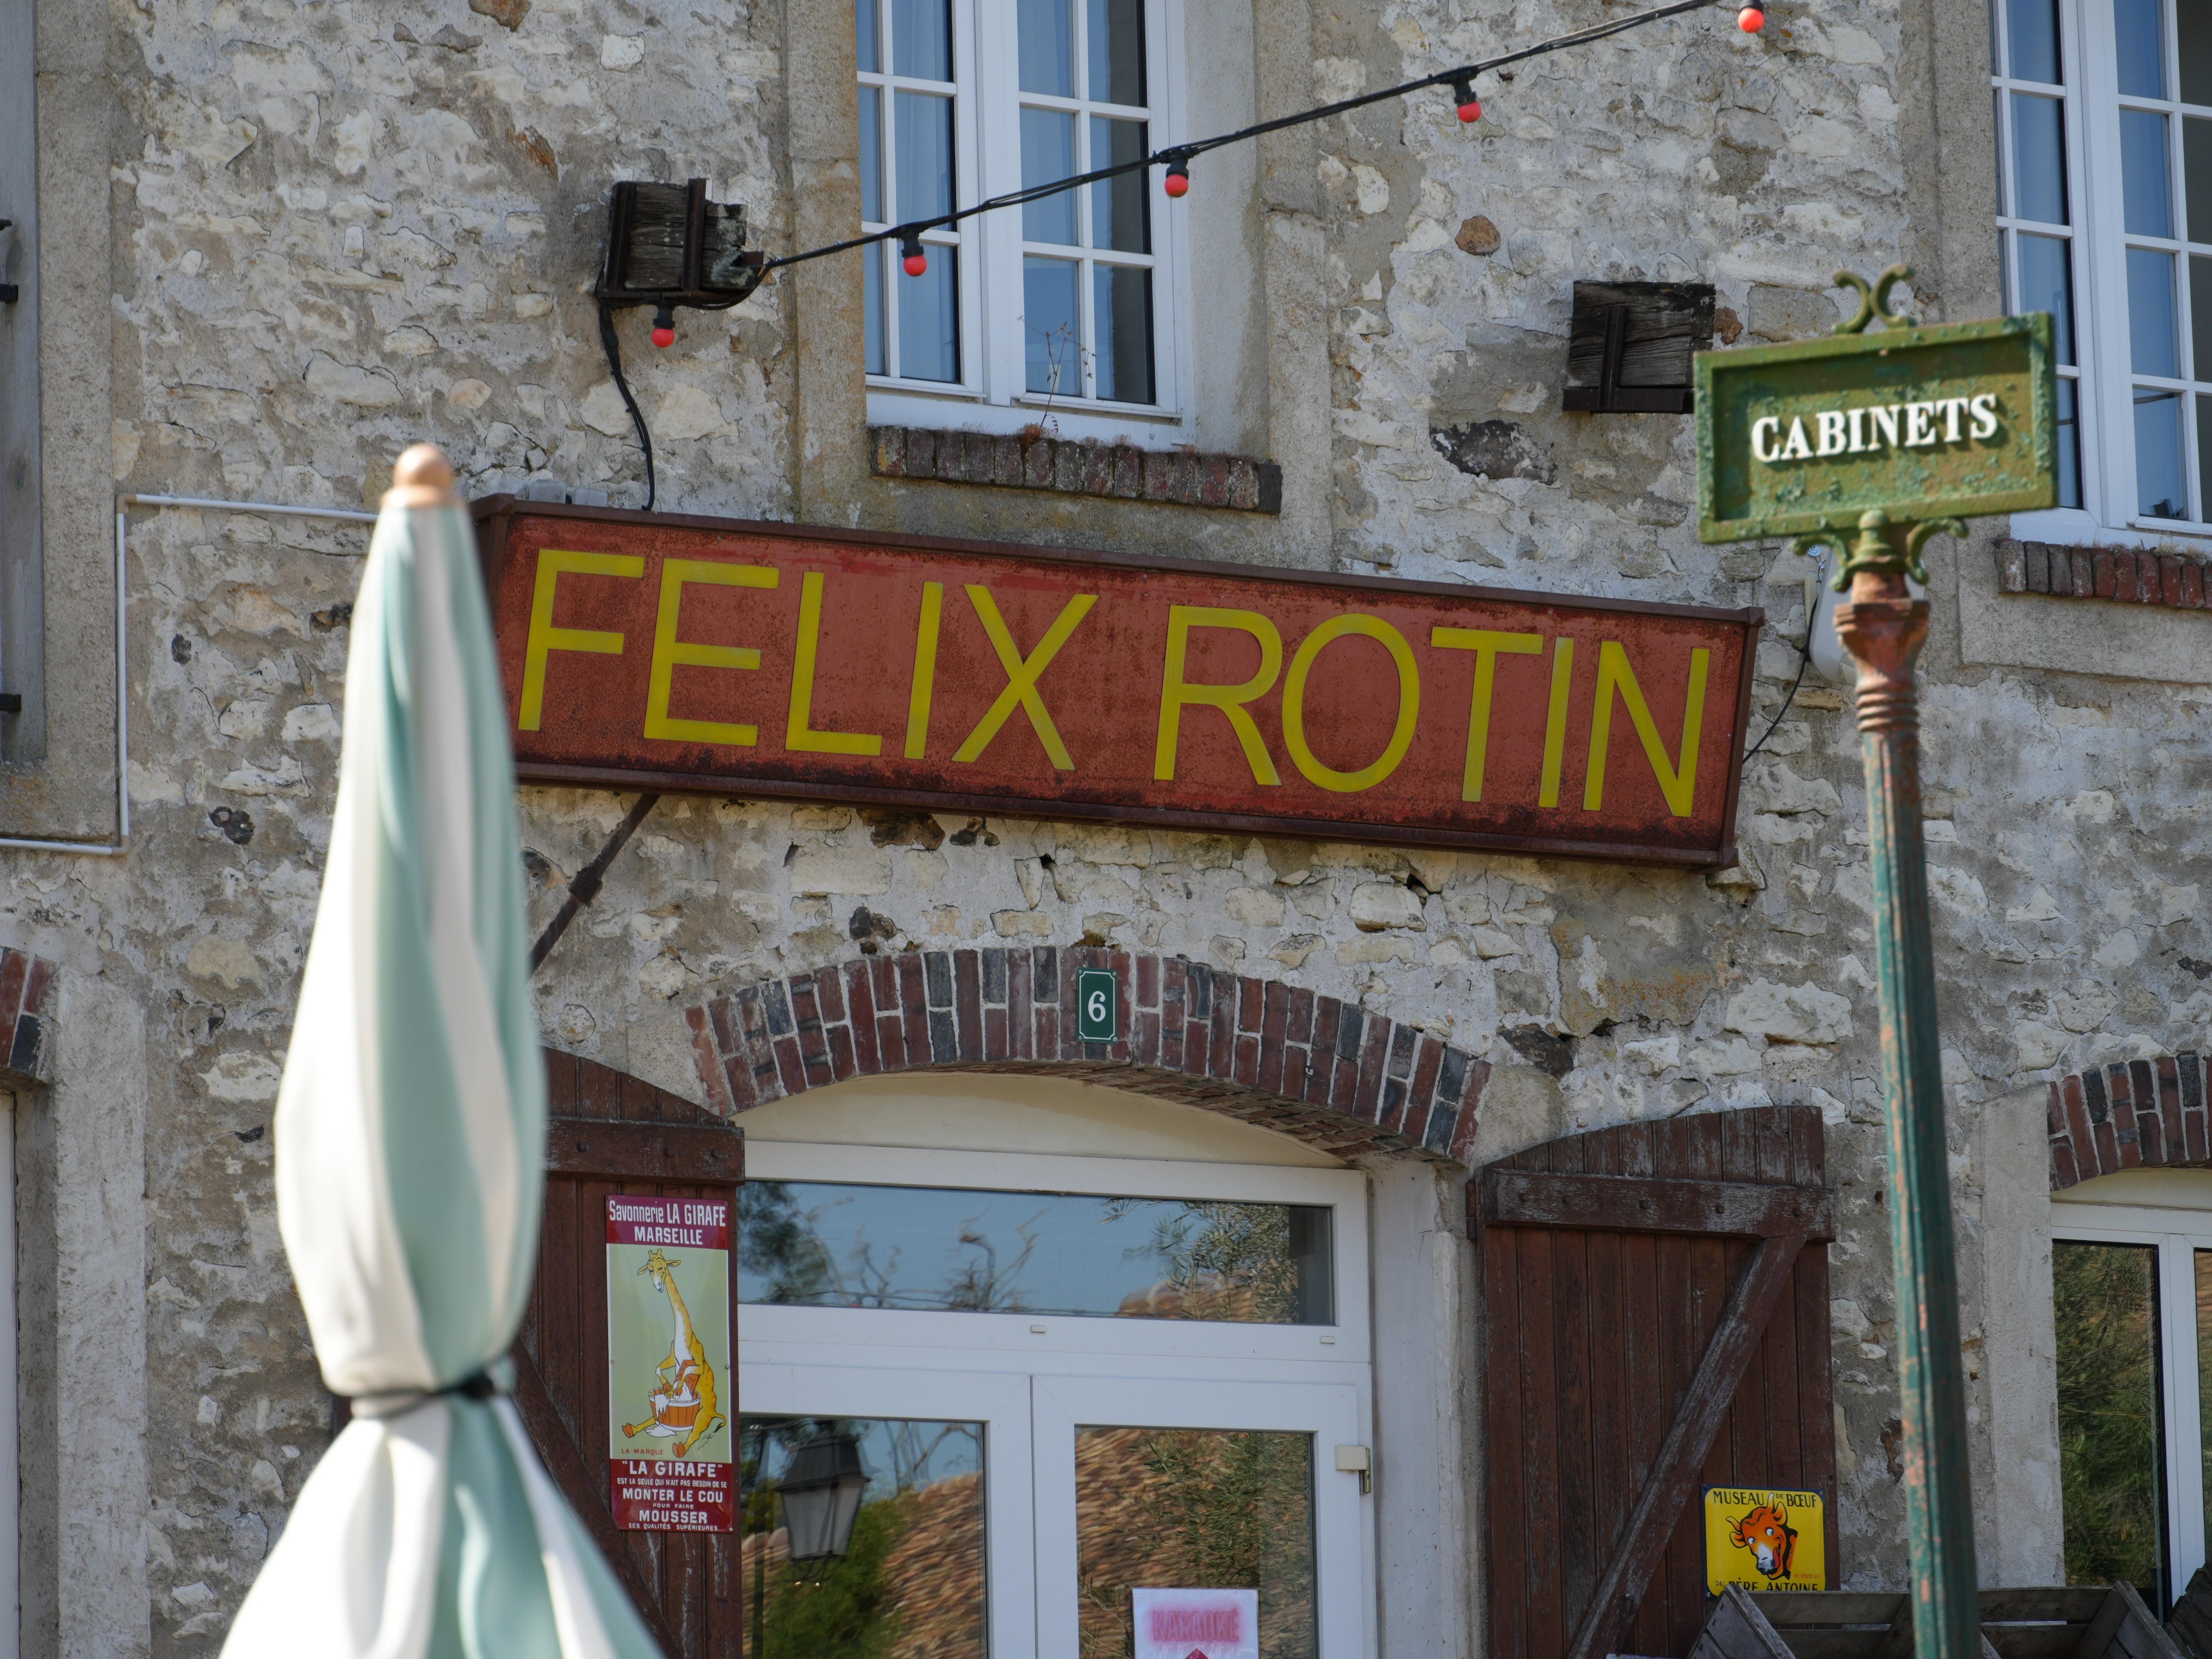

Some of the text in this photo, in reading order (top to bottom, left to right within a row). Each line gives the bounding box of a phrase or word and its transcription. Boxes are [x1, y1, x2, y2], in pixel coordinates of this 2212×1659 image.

[1751, 394, 1997, 463] CABINETS
[518, 549, 1710, 817] FELIX ROTIN
[1088, 991, 1106, 1022] 6
[609, 1200, 726, 1227] Savonnerie LA GIRAFE
[634, 1226, 703, 1245] MARSEILLE
[623, 1488, 723, 1503] MONTER LE COU
[1713, 1490, 1764, 1505] MUSEAU
[1786, 1493, 1817, 1507] BŒUF
[639, 1509, 708, 1524] MOUSSER
[1766, 1582, 1818, 1591] ANTOINE
[1152, 1608, 1239, 1642] KARAOKÉ
